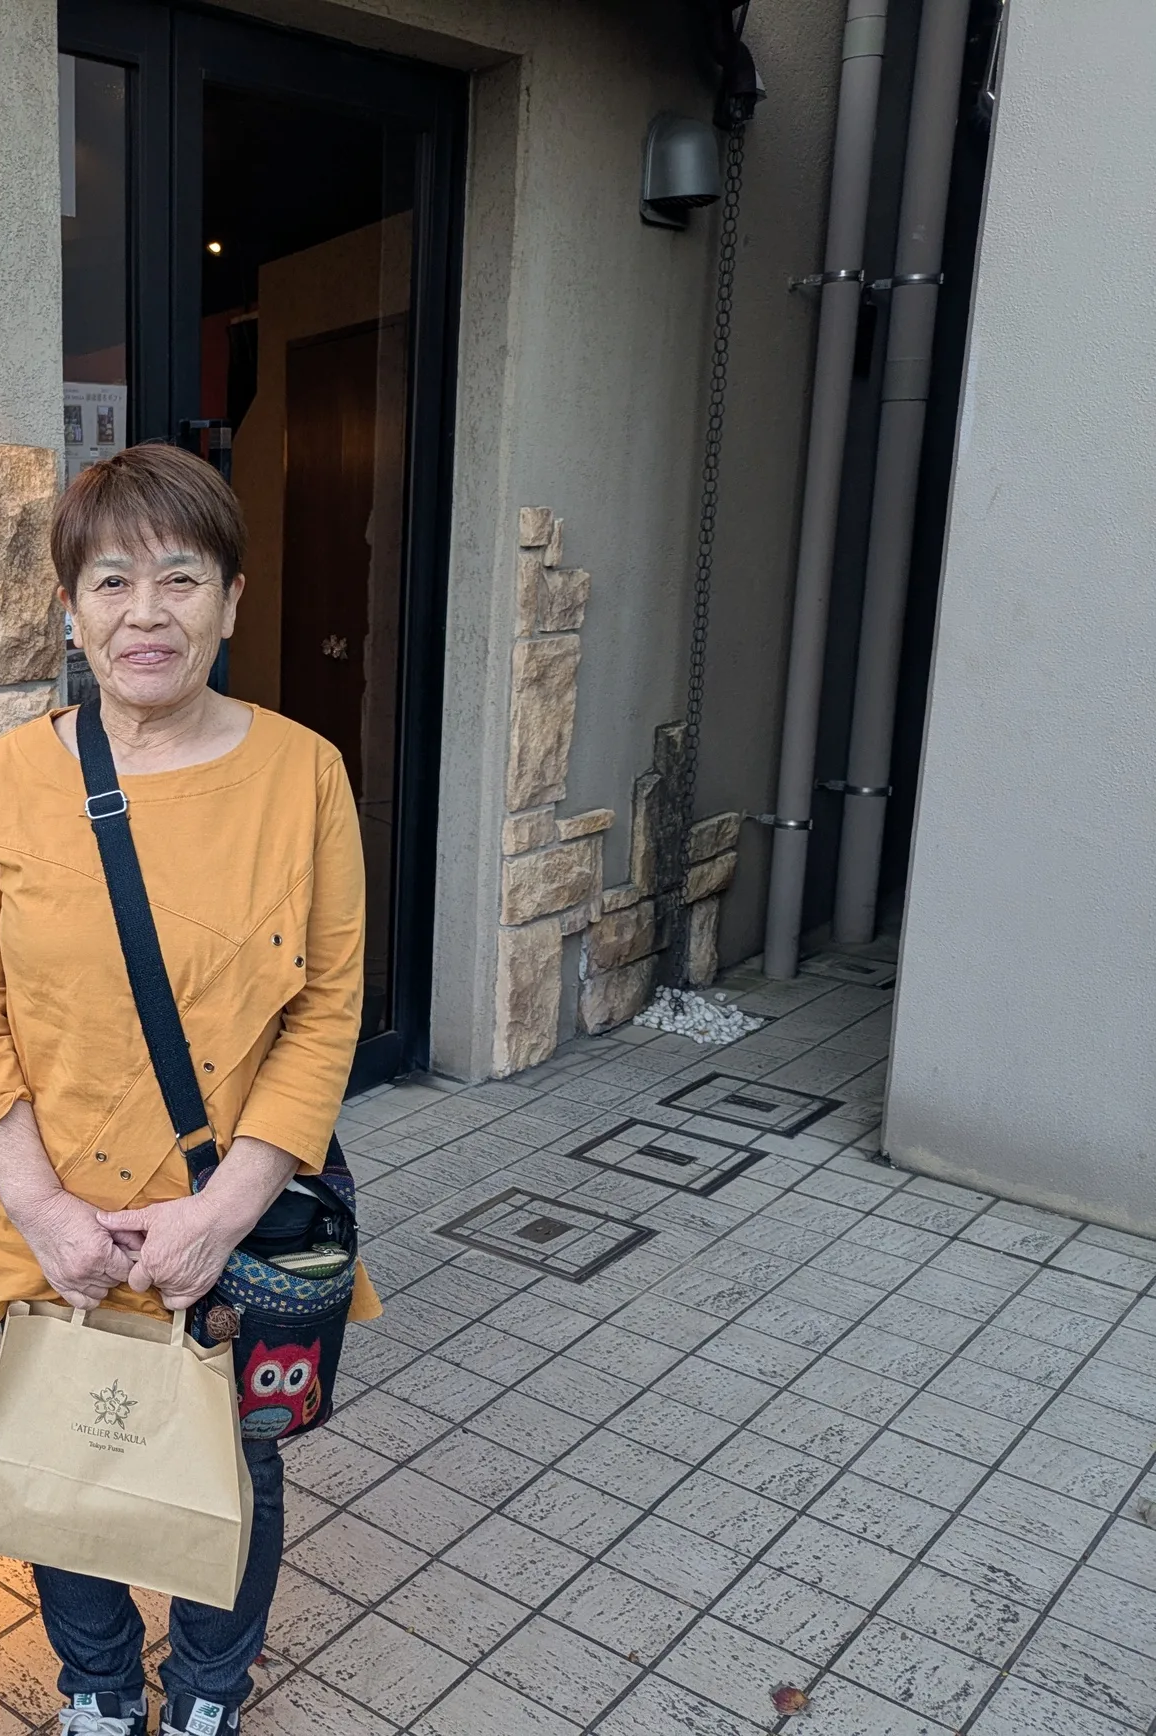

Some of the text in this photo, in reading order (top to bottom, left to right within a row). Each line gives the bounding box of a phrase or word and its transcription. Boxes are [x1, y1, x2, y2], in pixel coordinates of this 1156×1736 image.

[71, 1421, 147, 1446] L'ATELIER SAKULA
[88, 1440, 107, 1451] Tokyo
[192, 1719, 213, 1735] 373
